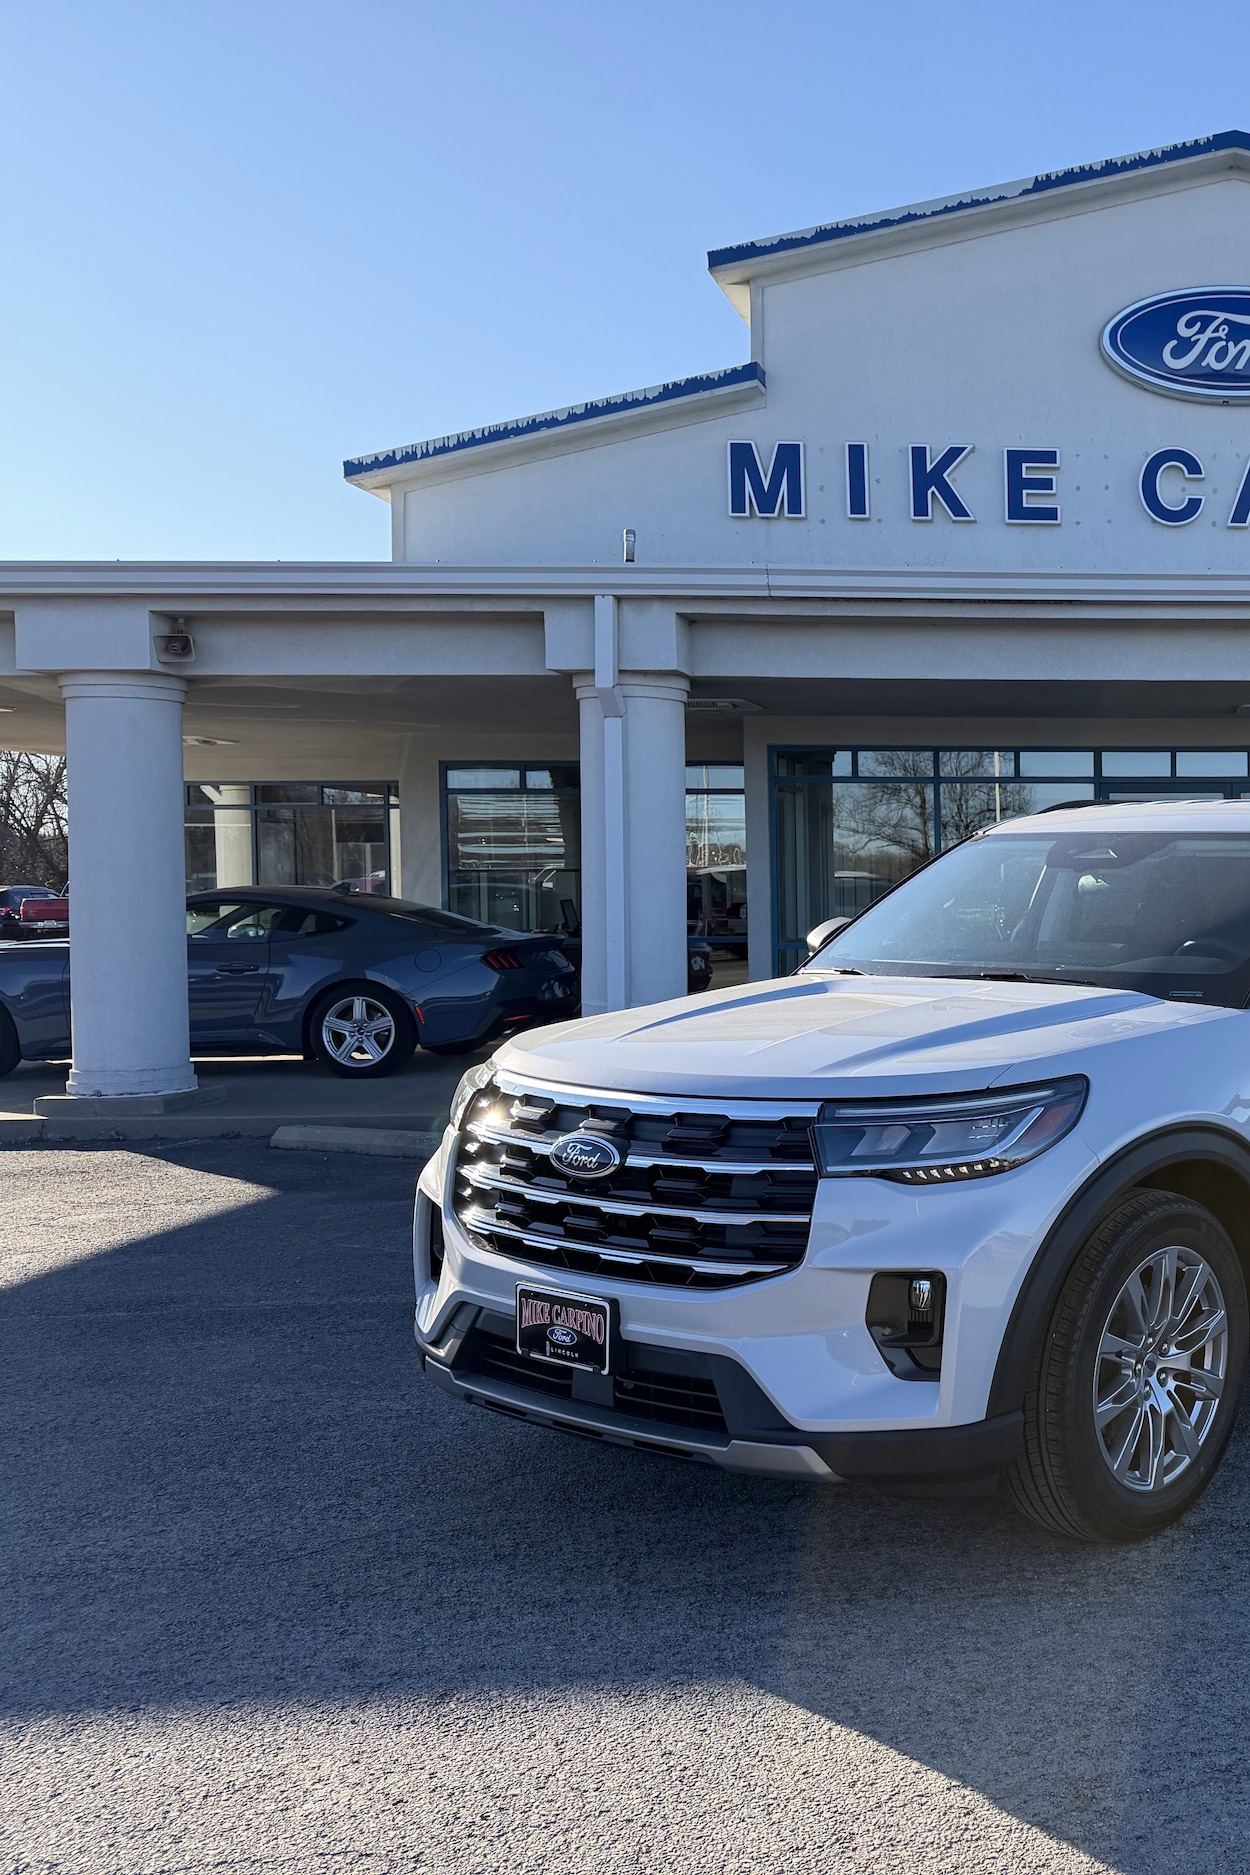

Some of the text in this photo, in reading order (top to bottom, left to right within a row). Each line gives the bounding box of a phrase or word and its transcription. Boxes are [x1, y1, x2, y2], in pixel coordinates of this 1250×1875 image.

[727, 439, 1062, 526] MIKE
[561, 1142, 601, 1169] Ford
[521, 1298, 604, 1344] MIKE CARPINO
[553, 1329, 571, 1342] Ford
[551, 1347, 579, 1358] LINCOLN
